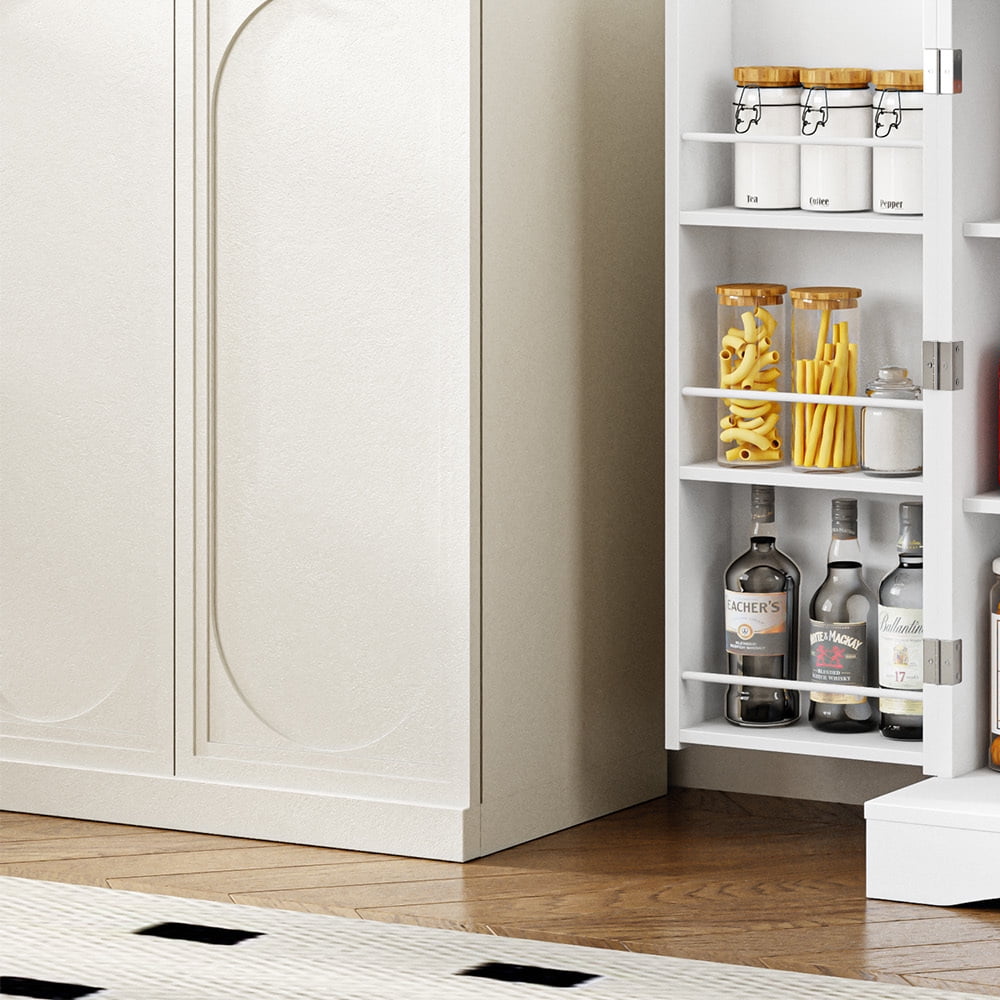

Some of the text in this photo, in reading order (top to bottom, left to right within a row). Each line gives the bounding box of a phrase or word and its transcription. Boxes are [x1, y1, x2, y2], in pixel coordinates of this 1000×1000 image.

[747, 195, 758, 204] Tea
[809, 196, 829, 206] Coffee
[880, 199, 903, 209] Pepper
[880, 612, 924, 634] Ballantin
[895, 671, 906, 682] 17
